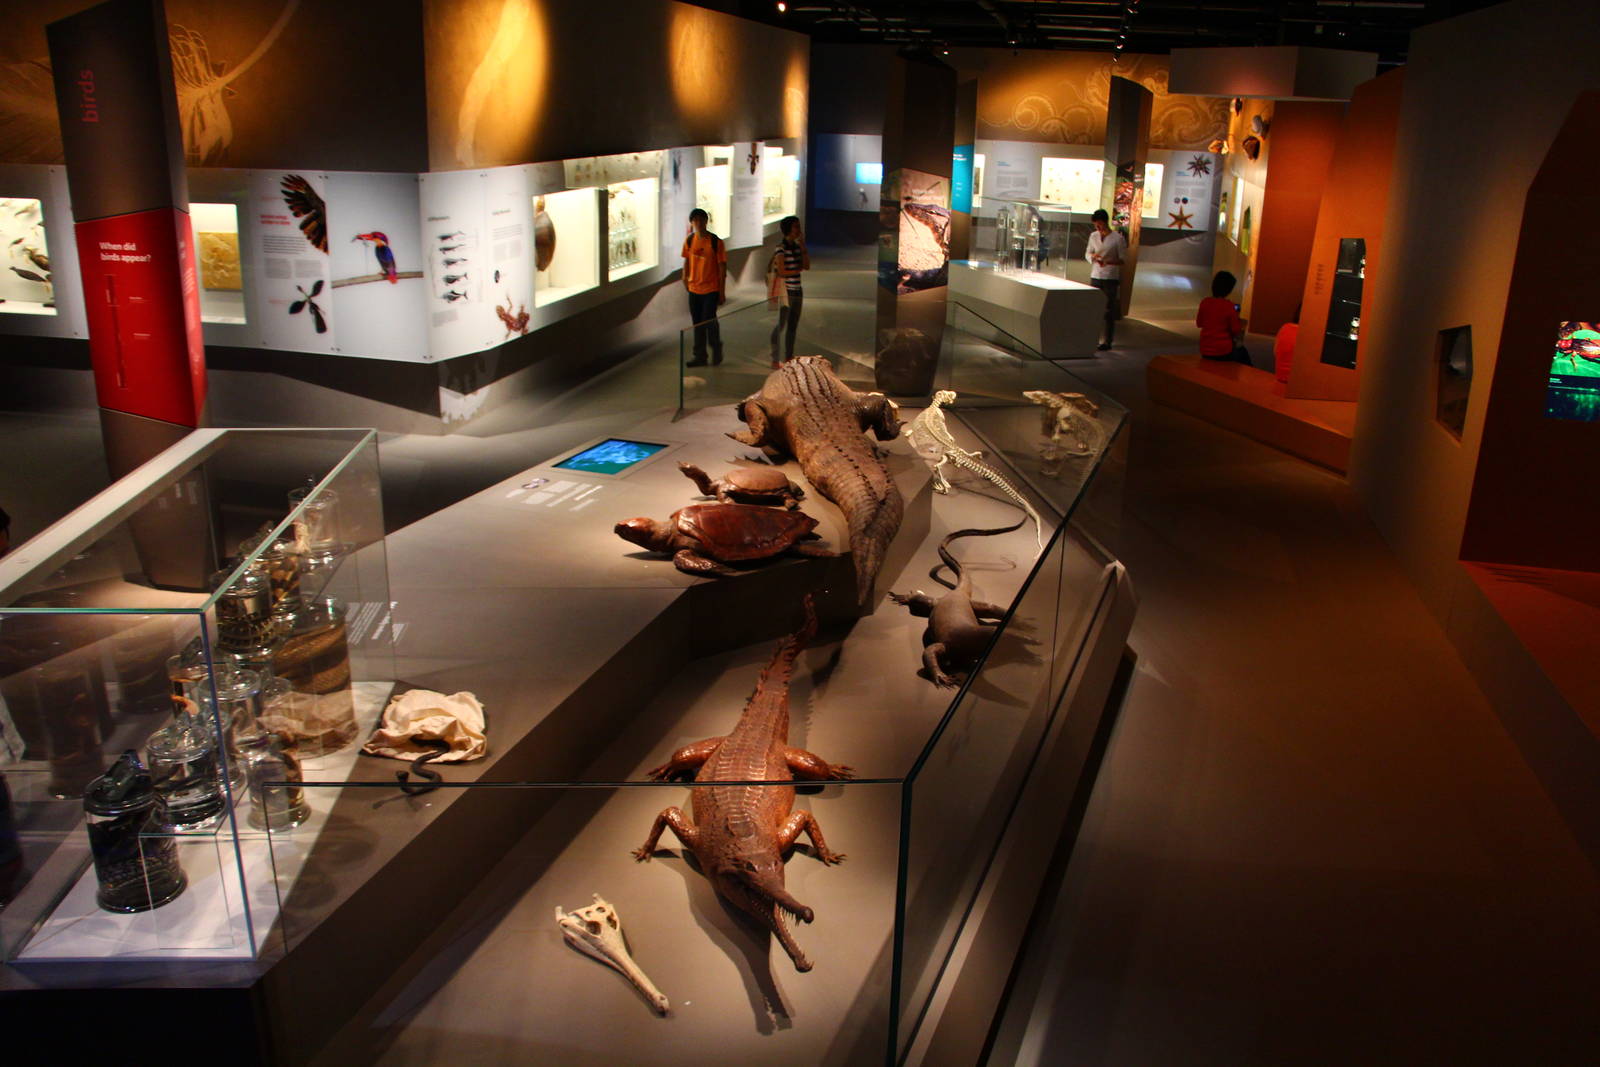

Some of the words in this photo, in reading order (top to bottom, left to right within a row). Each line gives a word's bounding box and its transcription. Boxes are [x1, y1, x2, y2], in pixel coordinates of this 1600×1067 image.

[77, 70, 98, 122] birds
[99, 241, 122, 250] When
[123, 242, 136, 251] did
[100, 252, 120, 261] birds
[121, 254, 151, 263] appear?
